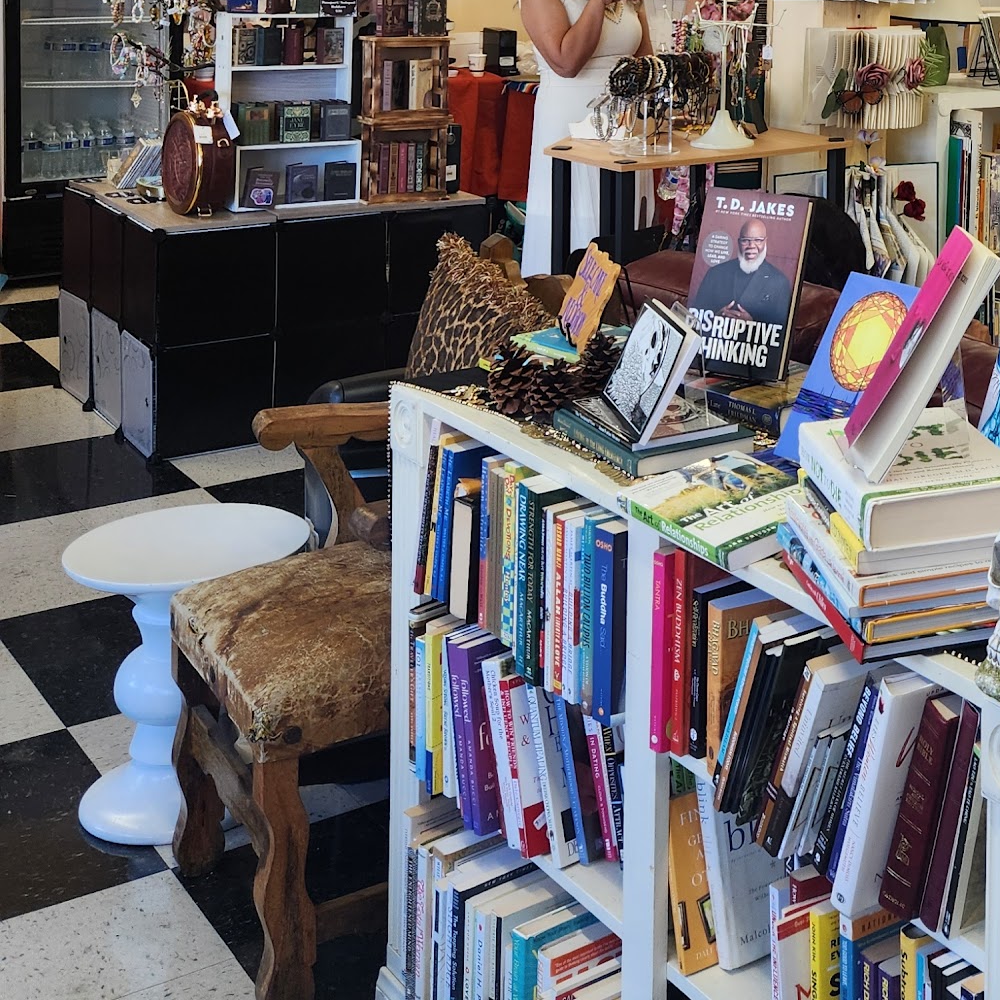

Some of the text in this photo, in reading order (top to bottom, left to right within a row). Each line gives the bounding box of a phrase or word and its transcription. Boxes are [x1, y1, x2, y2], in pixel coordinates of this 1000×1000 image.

[716, 196, 796, 218] T. D. JAKES
[688, 307, 783, 348] DISRUPTIVE
[698, 335, 769, 369] HINKING
[728, 401, 752, 414] THOMAS
[438, 467, 446, 502] LEADETH
[443, 470, 453, 521] LEADETH ME
[680, 491, 760, 523] The Art of
[694, 487, 803, 531] Relationship
[504, 507, 513, 560] DEVOTIONS
[594, 538, 614, 553] OSHO
[634, 506, 643, 517] The
[642, 509, 655, 527] Art
[661, 527, 710, 556] Relationships
[517, 494, 527, 646] DRAWING NEAR MACARTHUR
[525, 500, 536, 660] STRENGTH FOR TODAY MACARTHUR
[920, 566, 943, 574] simple
[948, 562, 974, 570] recipes
[554, 571, 562, 615] ALLAH
[581, 552, 592, 649] TWO BILLION CALIPHS
[600, 564, 609, 625] The Buddha
[654, 579, 662, 611] TANTRA
[673, 577, 684, 664] ZEN BUDDHISM
[553, 643, 561, 666] LOVE
[711, 619, 721, 677] BHAGAVAD
[484, 669, 497, 716] Mother's Soul
[490, 669, 499, 696] Chicken
[450, 674, 462, 719] followed.
[458, 734, 466, 770] AMANDA
[492, 696, 501, 715] Soup
[844, 685, 873, 758] BEYOND BELIEF
[460, 679, 477, 806] followed. AMANDA BUCCI
[504, 689, 518, 770] HOW TO WIN FRIENDS
[527, 695, 546, 781] QUANTUM HEALING
[555, 697, 575, 794] THE MISSION MOTHERHOOD
[504, 739, 513, 770] PEOPLE
[588, 736, 601, 779] IN DATING
[779, 745, 793, 772] Mismatch
[854, 757, 862, 769] The
[601, 726, 625, 845] WHEN OPPOSITES ATTRACT
[696, 781, 710, 826] blink
[852, 782, 867, 827] BELIEVE
[450, 929, 459, 959] Tapping
[739, 923, 771, 947] Malcol
[451, 960, 459, 991] Solution
[476, 938, 484, 976] Daniel
[513, 958, 521, 980] Brain
[863, 961, 871, 989] RICH
